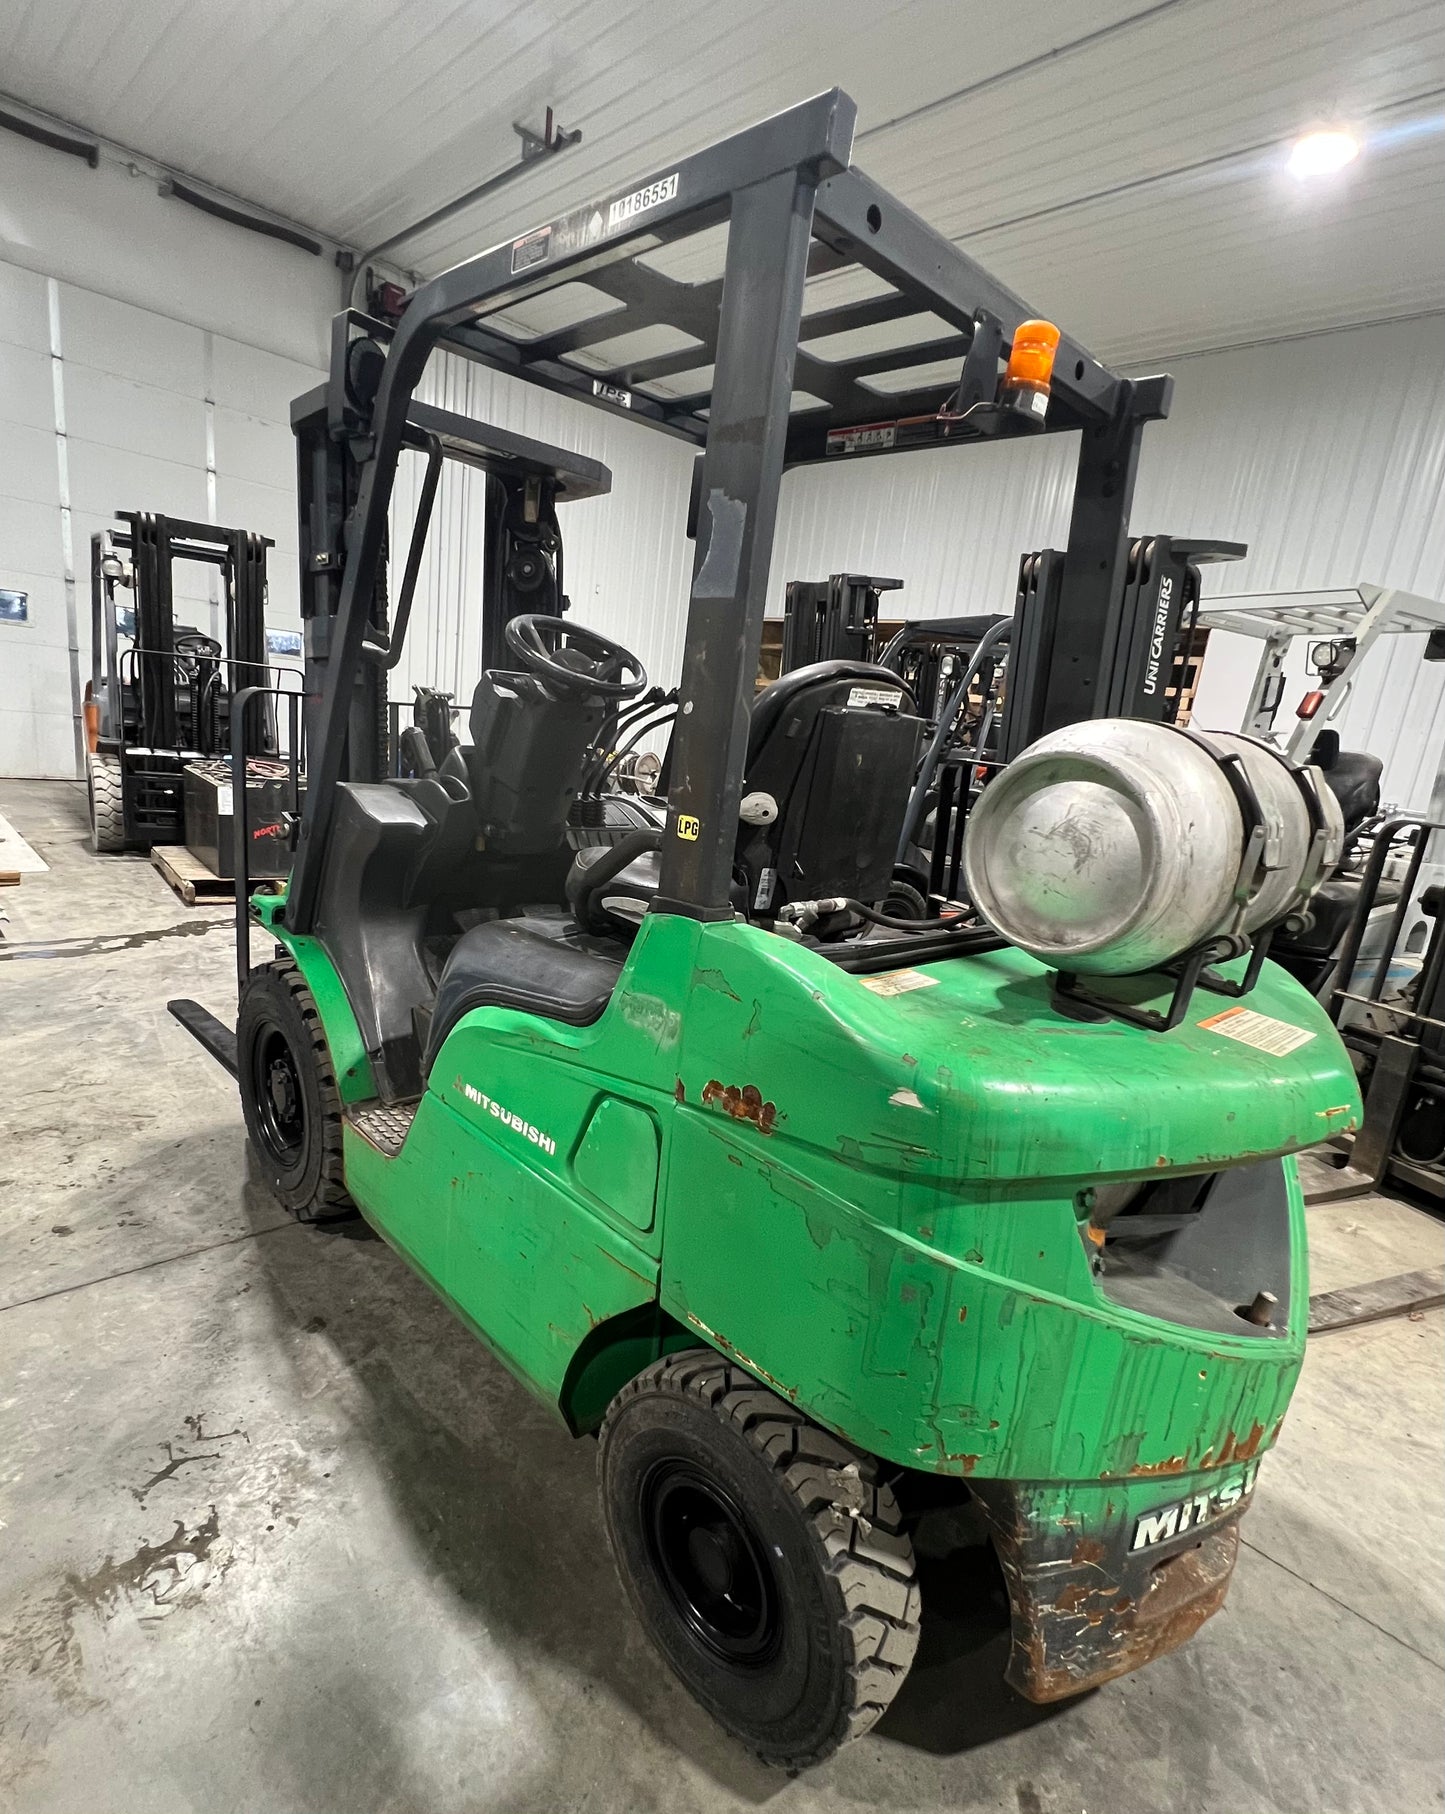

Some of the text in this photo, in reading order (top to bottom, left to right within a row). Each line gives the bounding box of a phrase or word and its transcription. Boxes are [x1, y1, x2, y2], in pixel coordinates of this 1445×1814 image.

[612, 175, 676, 218] 10186551
[678, 819, 699, 836] LPG
[465, 1083, 556, 1156] MITSUBISHI
